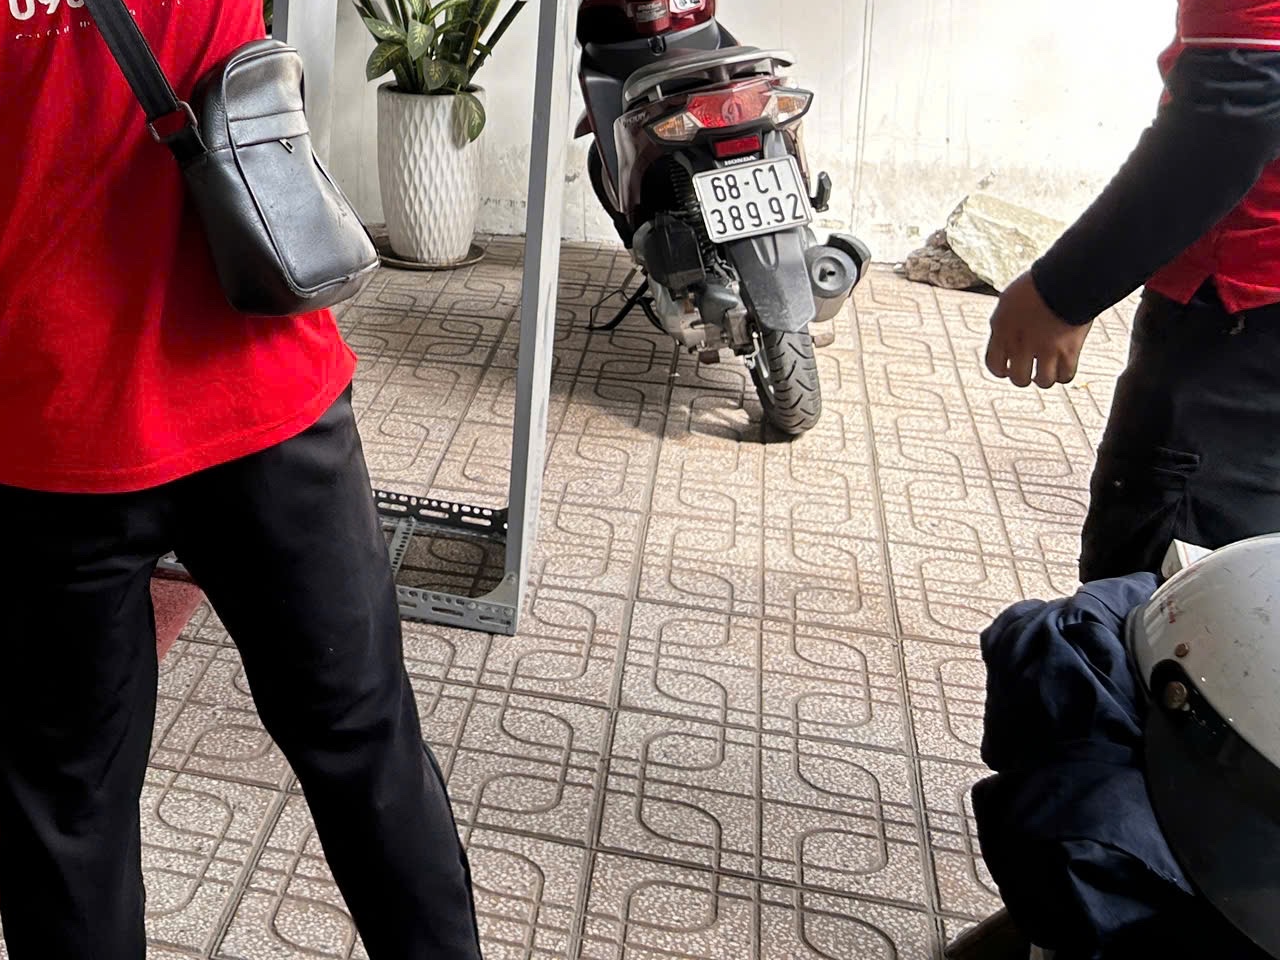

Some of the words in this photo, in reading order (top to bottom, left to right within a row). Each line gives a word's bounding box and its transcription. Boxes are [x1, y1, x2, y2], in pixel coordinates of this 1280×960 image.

[724, 154, 758, 166] HONDA
[710, 164, 783, 203] 68-C1
[710, 193, 805, 235] 389.92
